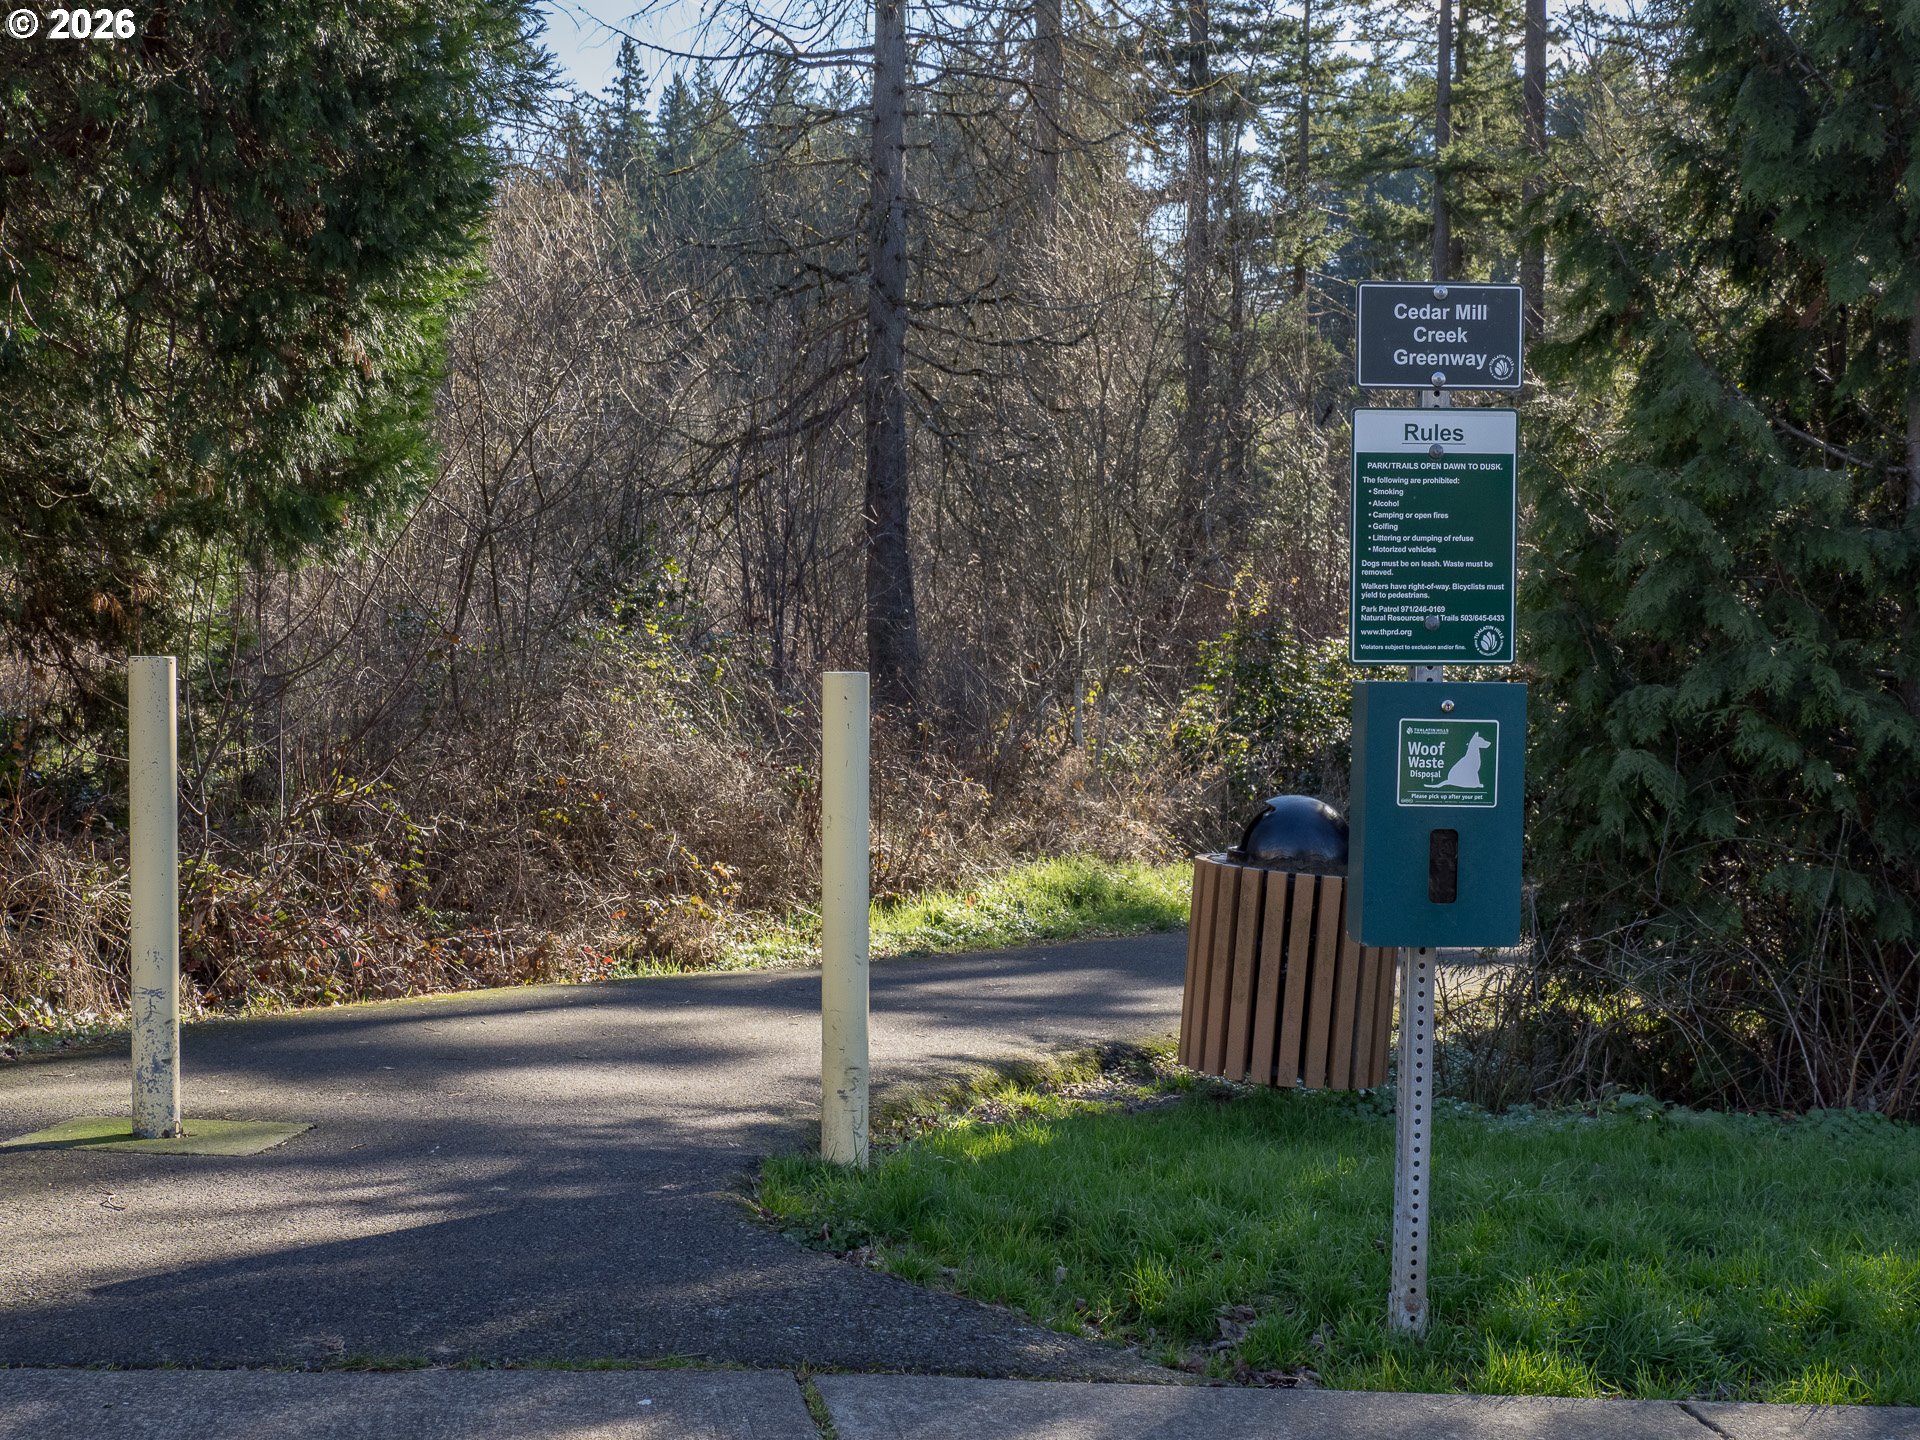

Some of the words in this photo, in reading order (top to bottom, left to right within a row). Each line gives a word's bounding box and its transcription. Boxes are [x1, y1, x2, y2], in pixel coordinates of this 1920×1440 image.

[1394, 303, 1450, 320] Cedar
[1455, 304, 1487, 320] Mill
[1413, 326, 1468, 343] Creek
[1393, 349, 1487, 370] Greenway
[1404, 423, 1464, 442] Rules
[1367, 462, 1419, 470] PARK/TRAILS
[1480, 463, 1503, 471] DUSK.
[1377, 477, 1408, 485] following
[1423, 477, 1460, 485] prohibited:
[1373, 488, 1404, 496] Smoking
[1373, 512, 1404, 520] Camping
[1373, 523, 1398, 531] Golfing
[1372, 535, 1401, 543] Littering
[1412, 535, 1442, 543] dumping
[1361, 560, 1380, 568] Dogs
[1408, 583, 1450, 591] right-of-way.
[1452, 583, 1485, 591] Bicyclists
[1361, 592, 1378, 600] yield
[1387, 592, 1430, 600] pedestrians.
[1360, 628, 1412, 636] www.thprd.org
[1408, 742, 1445, 755] Woof
[1408, 757, 1444, 768] Waste
[1410, 770, 1440, 780] Disposal
